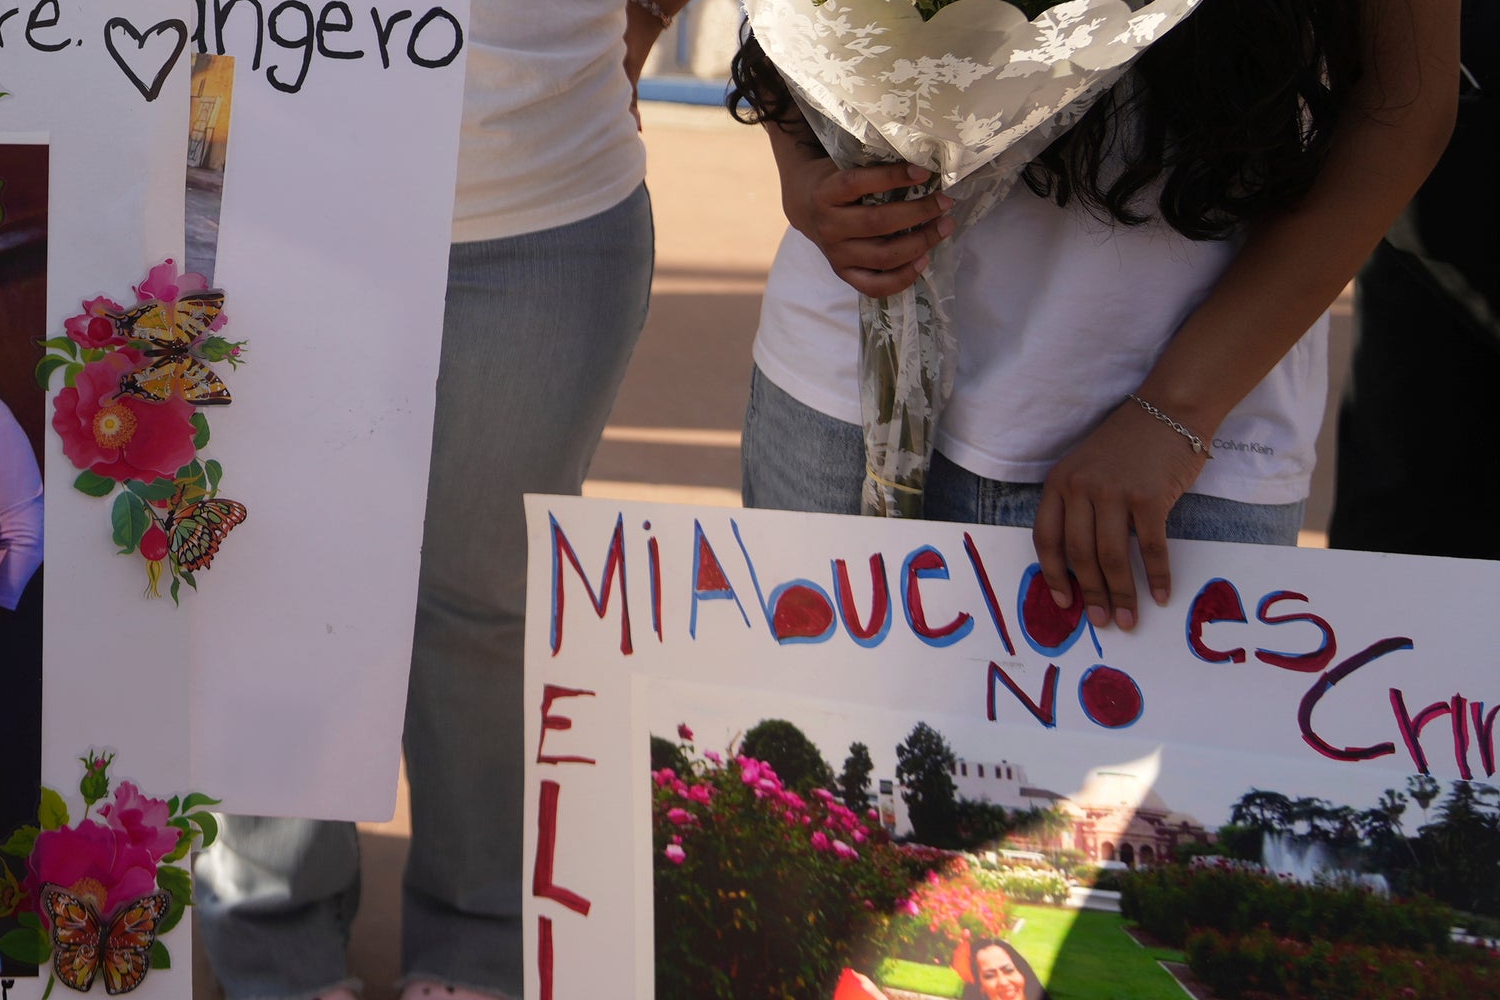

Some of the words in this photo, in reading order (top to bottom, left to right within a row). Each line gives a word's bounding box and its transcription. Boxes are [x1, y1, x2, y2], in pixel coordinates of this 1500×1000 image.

[1212, 438, 1249, 452] Calvin
[1250, 442, 1275, 456] Klein
[548, 509, 663, 657] Mi
[1186, 577, 1338, 673] es
[986, 660, 1145, 729] NO
